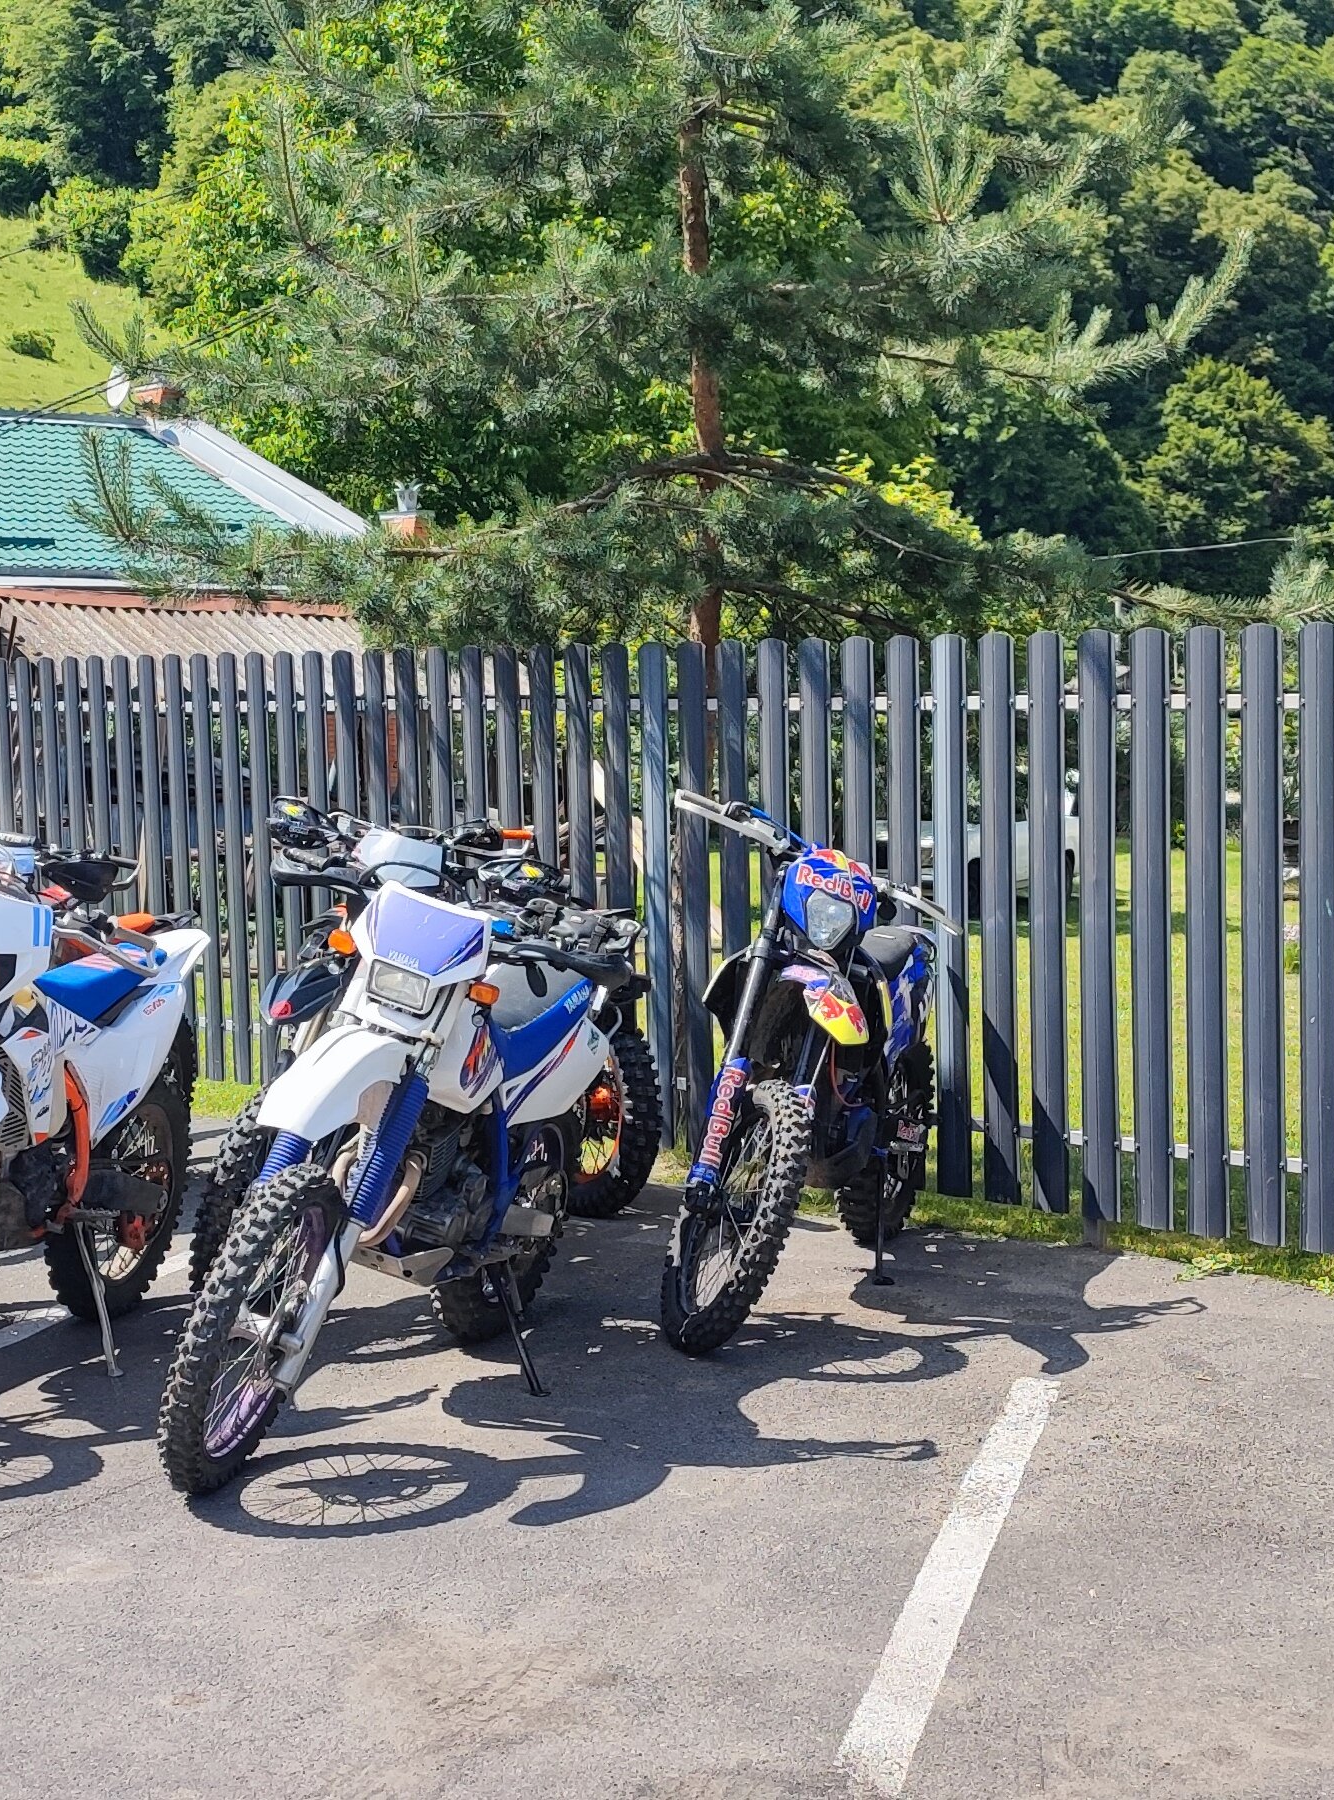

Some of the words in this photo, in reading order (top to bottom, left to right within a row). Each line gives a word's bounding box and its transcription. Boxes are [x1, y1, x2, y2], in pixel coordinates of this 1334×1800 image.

[795, 863, 839, 895] Red
[388, 949, 420, 970] YAMAHA
[712, 1066, 746, 1120] Red
[699, 1116, 732, 1169] Bull
